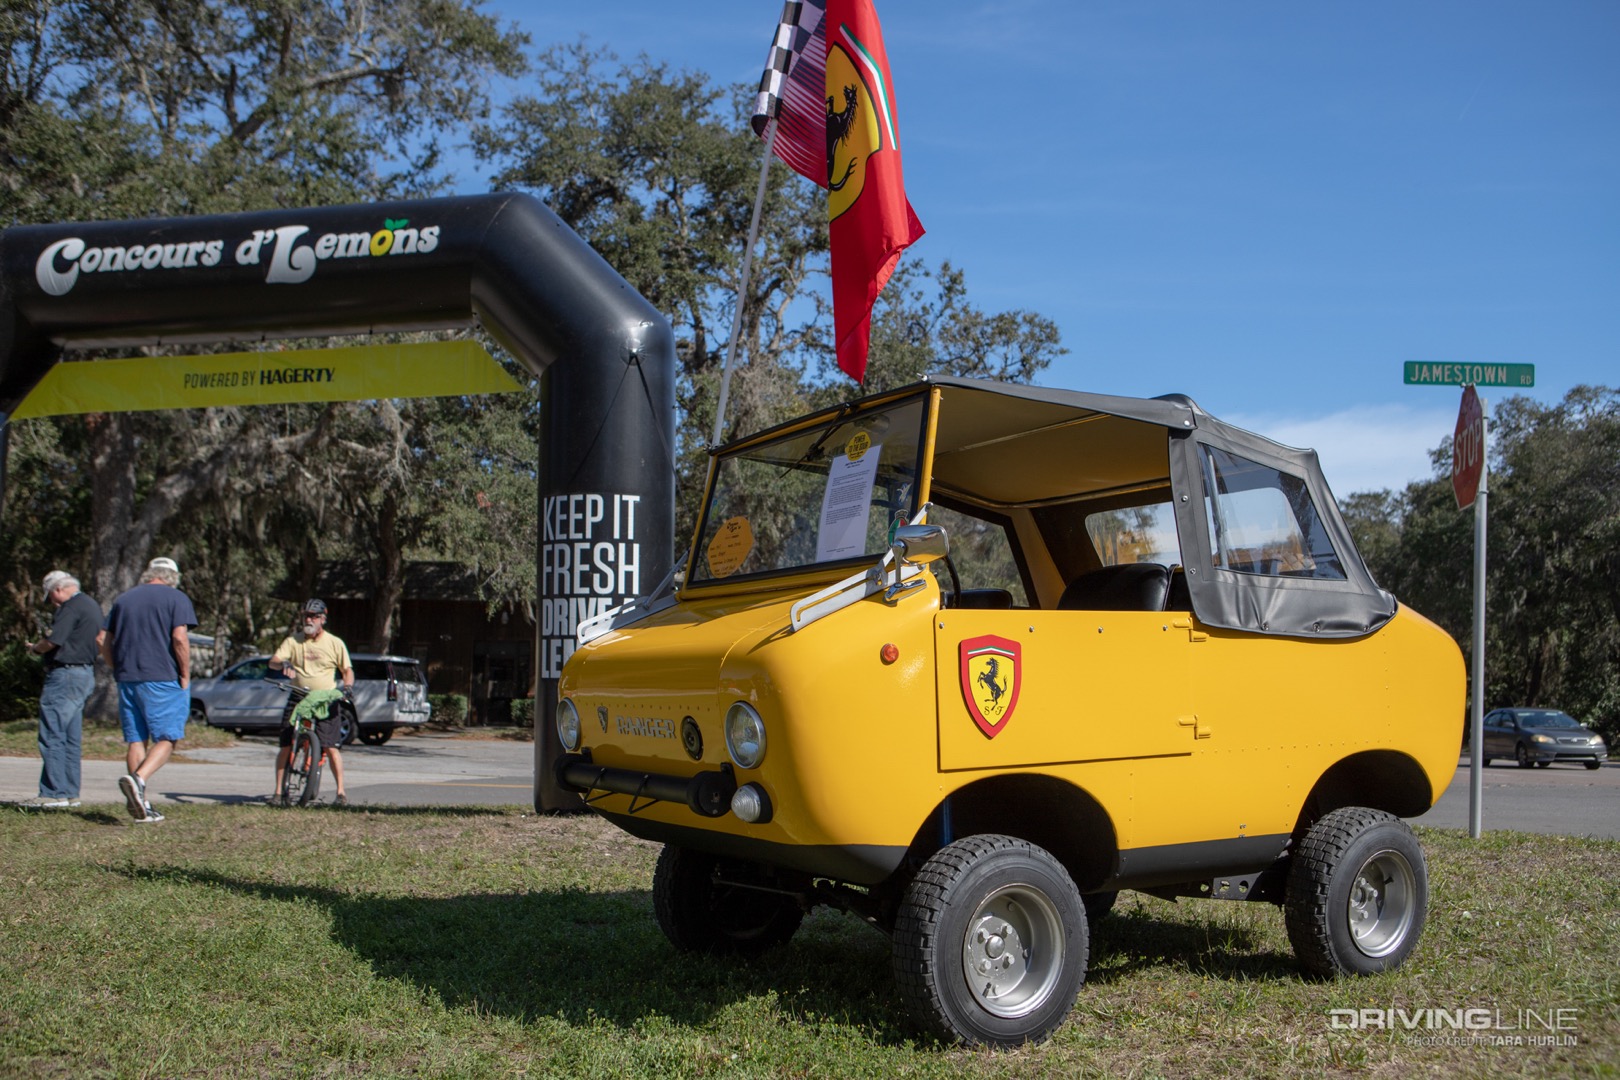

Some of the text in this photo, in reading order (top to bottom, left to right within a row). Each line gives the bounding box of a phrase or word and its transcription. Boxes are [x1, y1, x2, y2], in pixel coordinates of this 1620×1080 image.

[36, 237, 224, 296] Concours
[184, 368, 335, 389] POWERED BY HAGERTY
[1410, 364, 1532, 385] JAMESTOWN RD
[1455, 419, 1482, 476] STOP
[543, 494, 641, 541] KEEP IT
[543, 542, 640, 595] FRESH
[615, 715, 677, 739] RANGER
[984, 706, 990, 715] S
